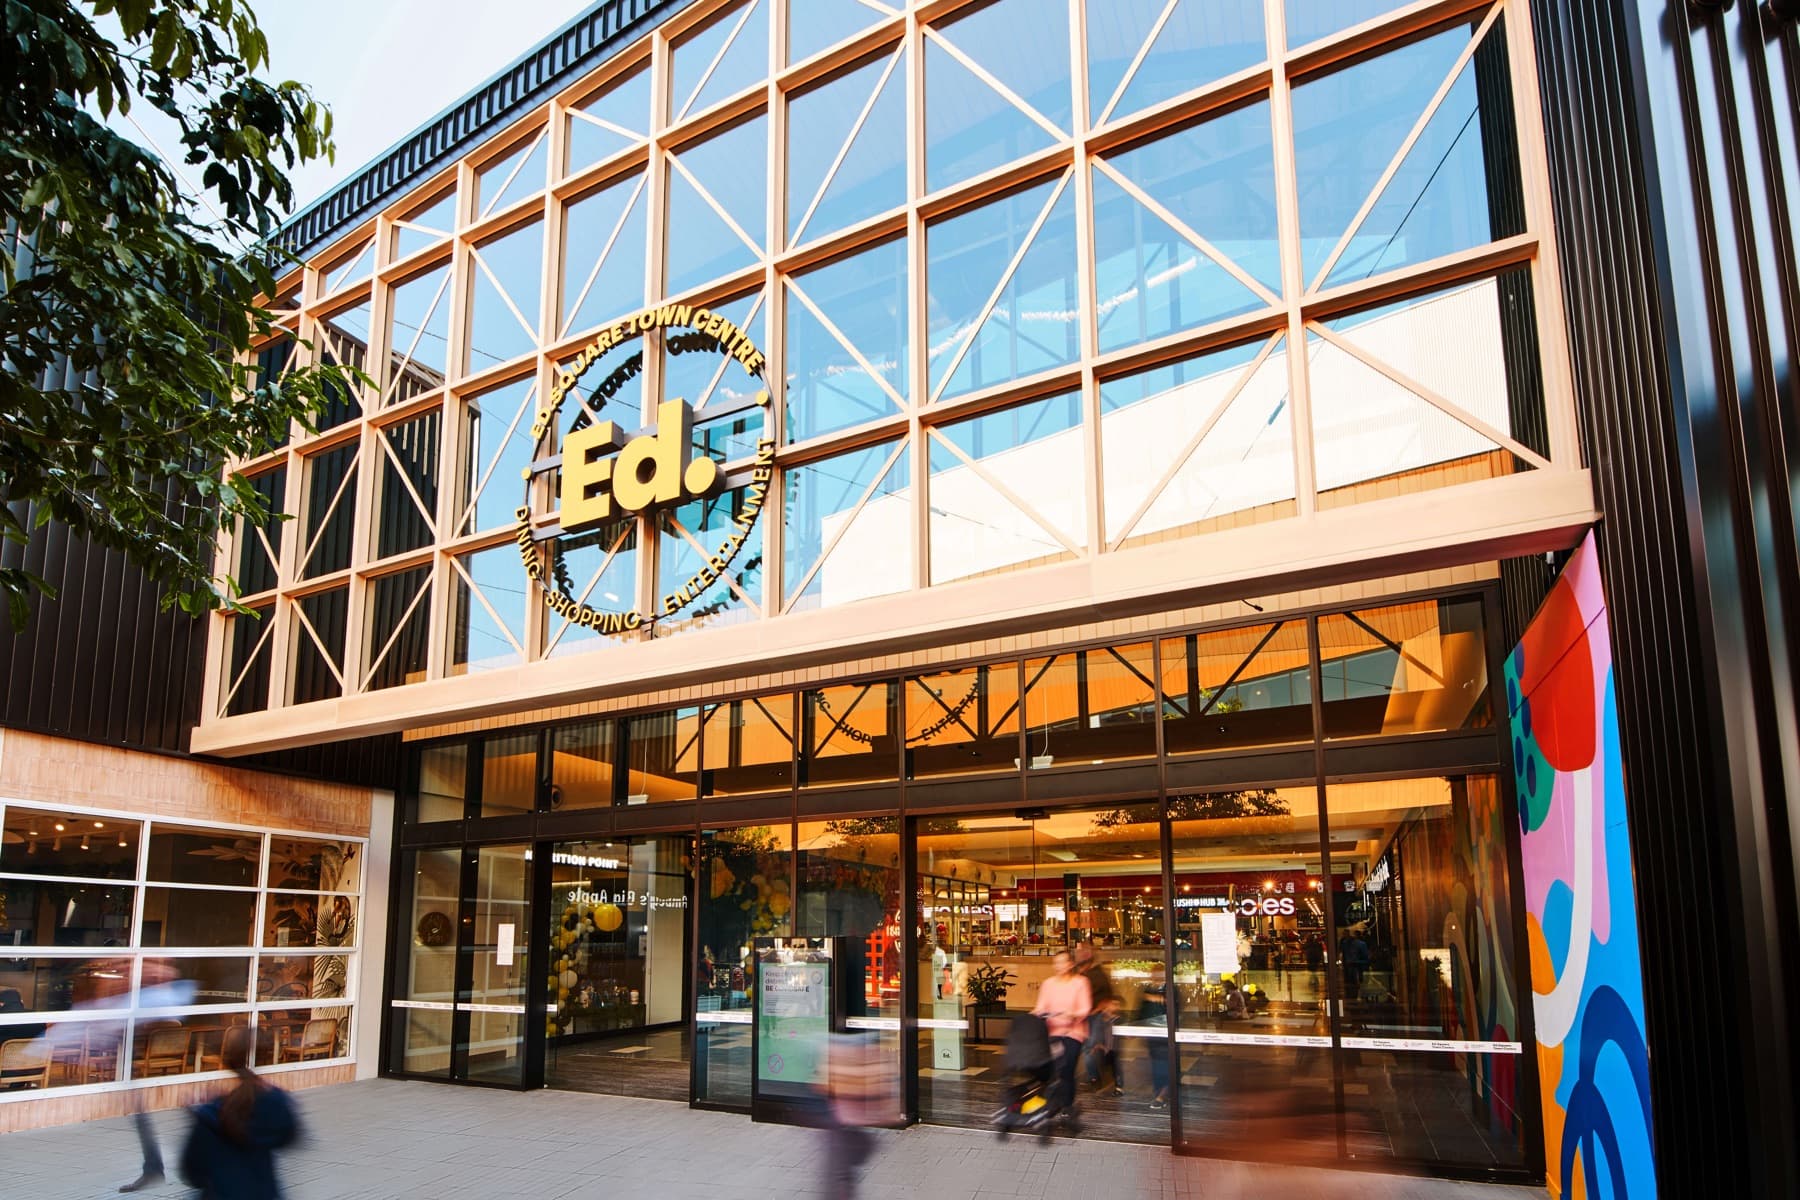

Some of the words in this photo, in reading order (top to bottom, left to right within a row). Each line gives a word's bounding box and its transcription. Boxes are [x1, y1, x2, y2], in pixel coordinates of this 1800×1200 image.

[530, 407, 551, 439] ED
[551, 325, 625, 409] SQUARE
[625, 305, 693, 334] TOWN
[693, 309, 765, 377] CENTRE
[560, 397, 722, 530] Ed.
[515, 505, 541, 579] DINING
[545, 589, 642, 633] SHOPPING
[663, 437, 775, 615] ENTERTAINMENT
[588, 857, 619, 869] POINT
[1200, 898, 1216, 907] HUB
